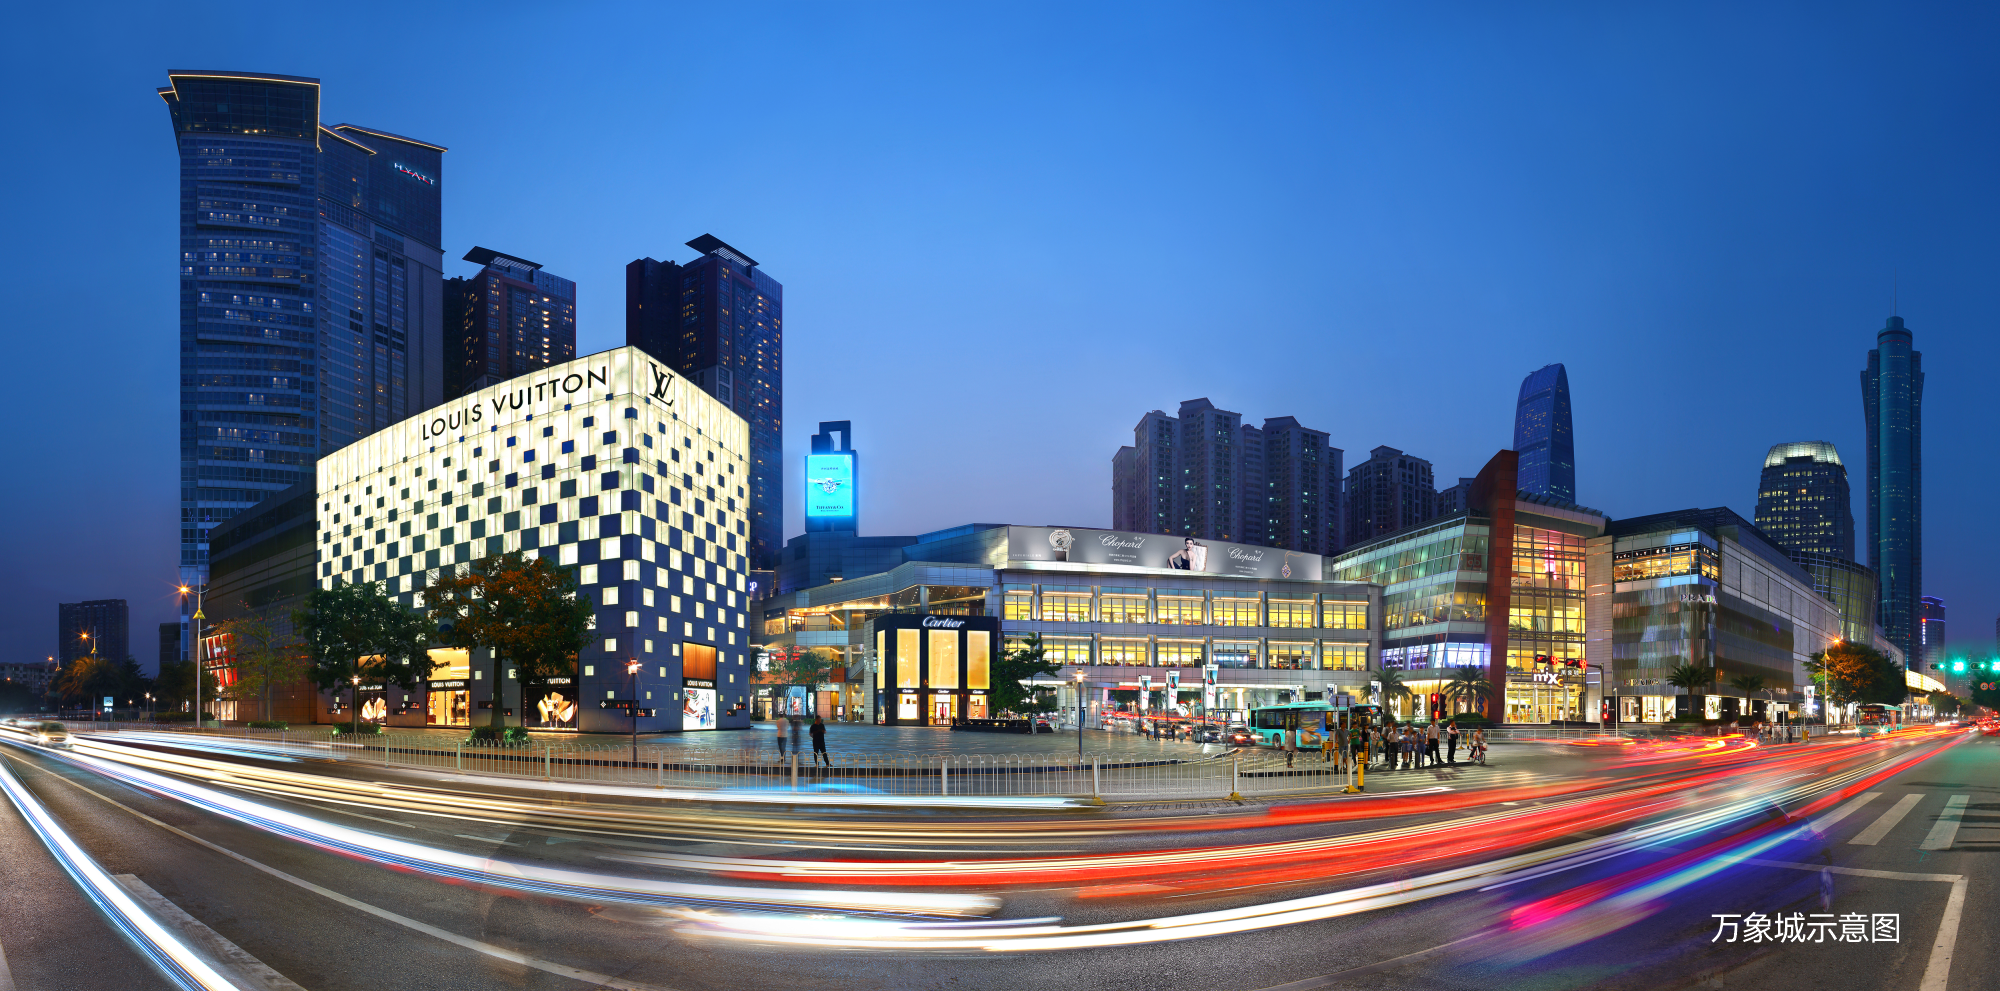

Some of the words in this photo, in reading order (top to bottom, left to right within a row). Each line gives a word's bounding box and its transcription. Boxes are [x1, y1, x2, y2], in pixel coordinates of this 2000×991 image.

[394, 162, 435, 185] HYATT
[422, 403, 482, 441] LOUIS
[491, 365, 607, 415] VUITTON
[1098, 534, 1146, 550] Chopard
[1227, 546, 1264, 562] Chopard
[1680, 593, 1718, 605] PRADA
[922, 616, 965, 628] Cartier
